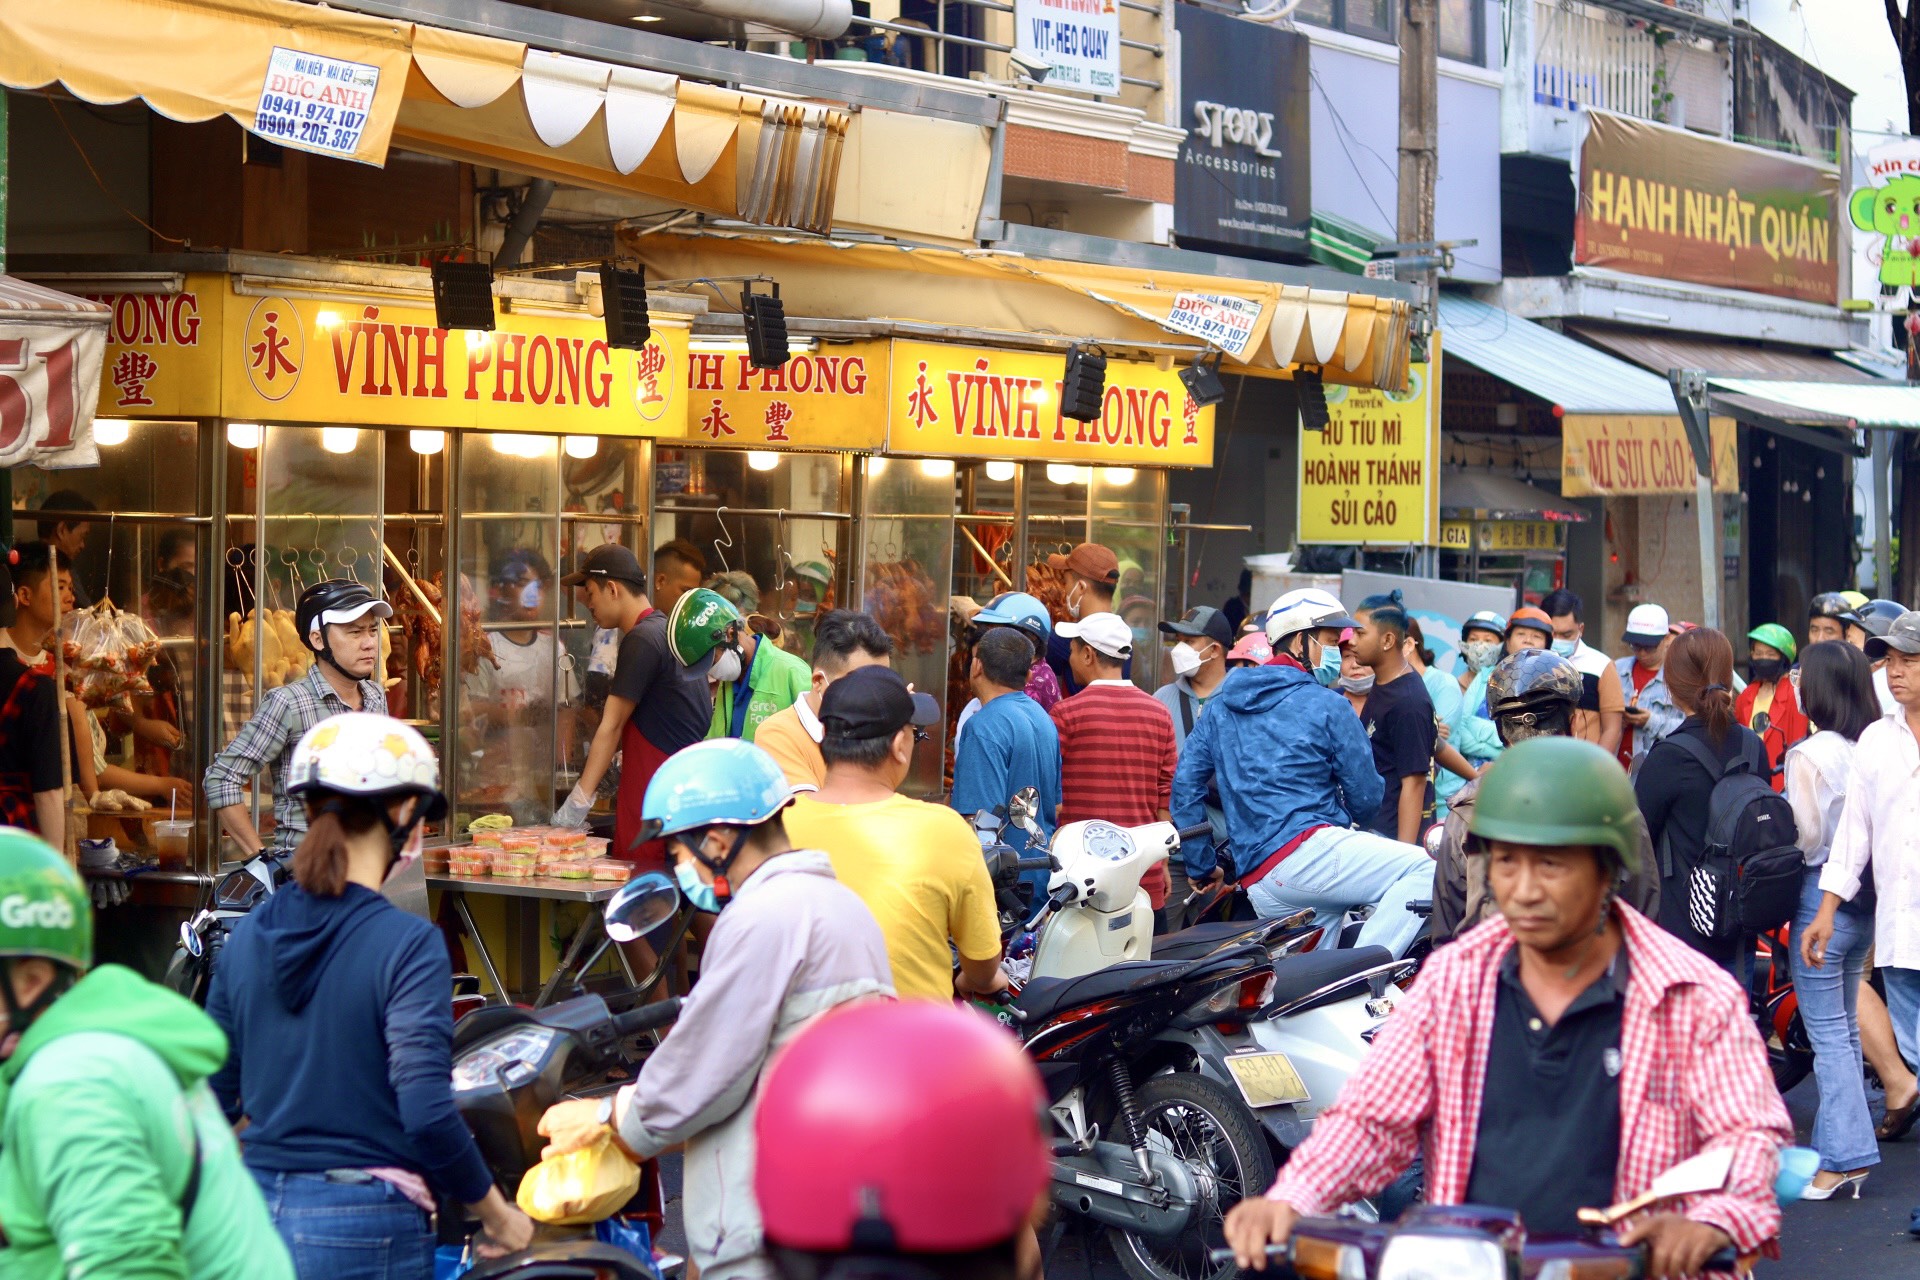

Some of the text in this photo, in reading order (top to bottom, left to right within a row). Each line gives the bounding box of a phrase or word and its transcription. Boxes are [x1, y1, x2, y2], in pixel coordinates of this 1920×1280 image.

[1081, 25, 1109, 60] QUAY
[269, 74, 368, 111] ĐỨC ANH
[262, 94, 365, 130] 0941.974.107
[257, 112, 359, 151] 0904.205.367
[1185, 148, 1276, 180] Accessories
[1871, 158, 1902, 176] xin
[1592, 169, 1829, 265] HẠNH NHẬT QUÁN
[1170, 309, 1249, 341] 0941.974.107
[1178, 297, 1213, 317] ĐỨC
[1213, 309, 1251, 330] ANH
[250, 311, 299, 382] 永
[329, 305, 613, 409] VĨNH PHONG
[111, 350, 158, 407] 豐
[636, 342, 666, 406] 豐
[736, 354, 868, 396] PHONG
[907, 360, 939, 430] 永
[946, 358, 1043, 440] VĨNH
[701, 399, 793, 442] 永 豐
[1321, 409, 1402, 446] HỦ TÍU MÌ
[1304, 452, 1421, 486] HOÀNH THÁNH
[1586, 423, 1613, 489] MÌ
[1616, 420, 1647, 489] SỦI
[1650, 420, 1685, 489] CẢO
[1330, 490, 1397, 526] SỦI CẢO
[1446, 527, 1467, 544] GIA
[695, 601, 719, 627] Grab
[750, 701, 777, 713] Grab
[1, 894, 74, 930] Grab
